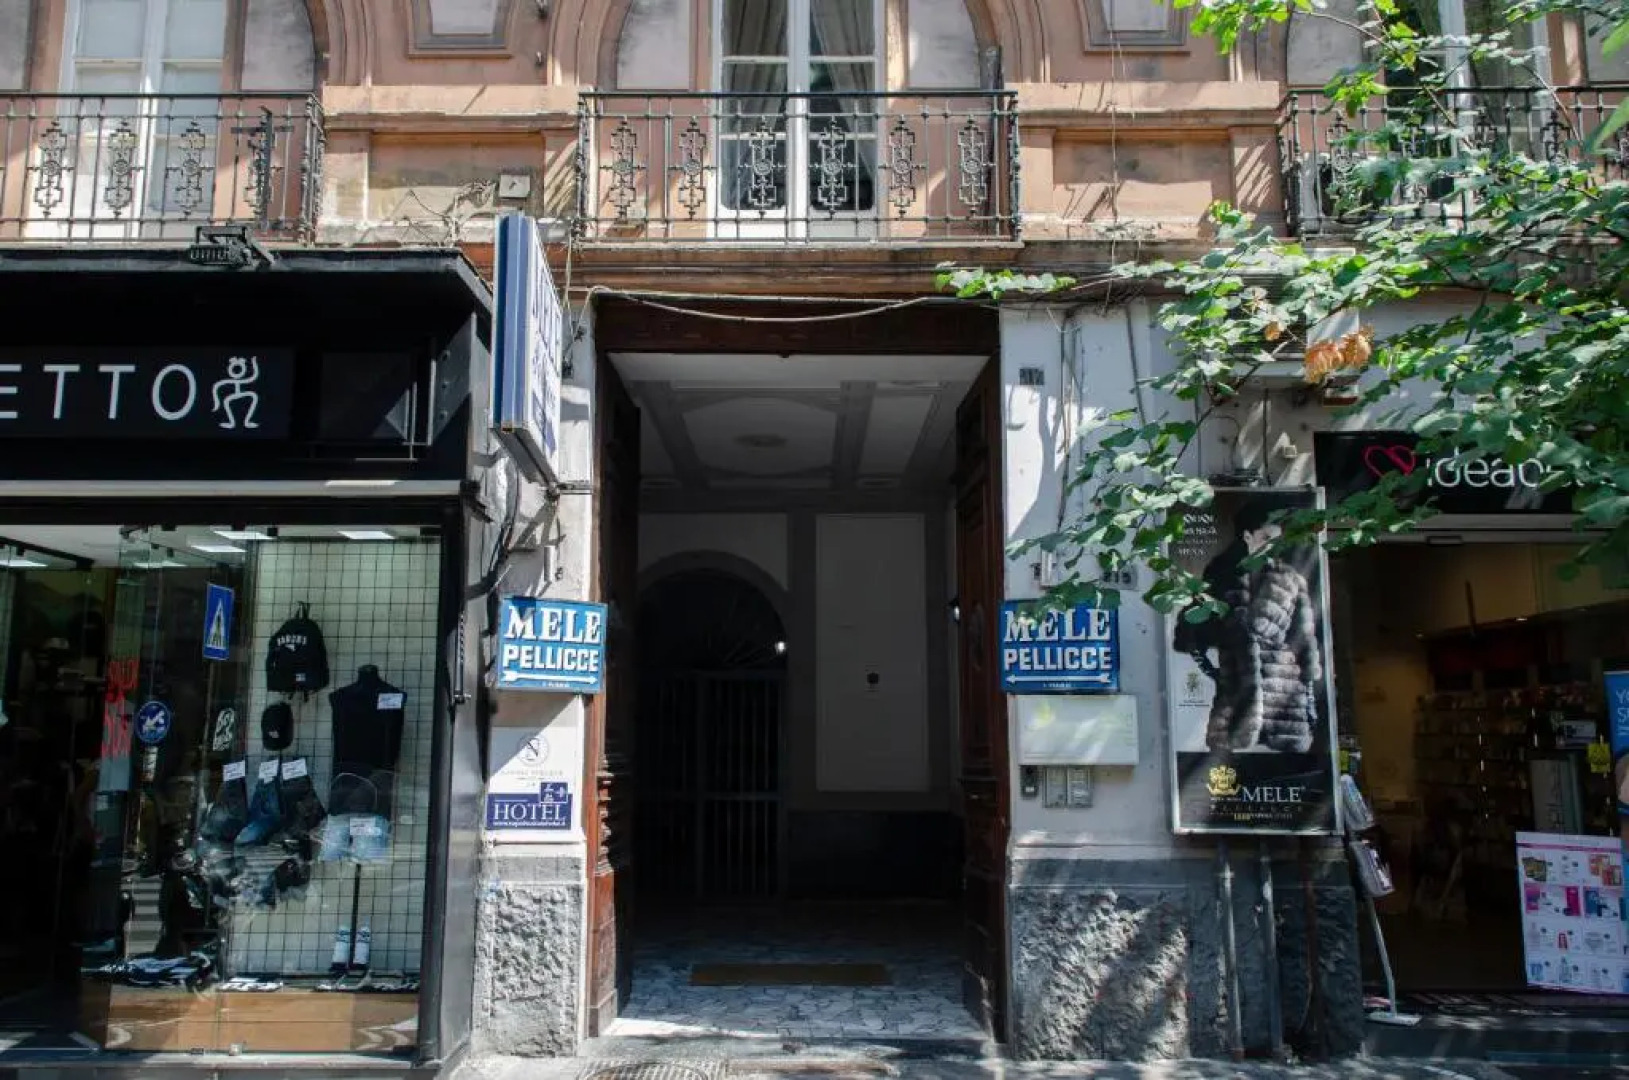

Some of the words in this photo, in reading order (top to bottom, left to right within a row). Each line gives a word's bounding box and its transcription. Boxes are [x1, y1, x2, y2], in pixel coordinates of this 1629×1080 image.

[504, 605, 601, 644] MELE
[1004, 608, 1111, 642] MELE
[503, 643, 599, 672] PELLICCE
[1003, 646, 1112, 670] PELLICCE
[1242, 785, 1302, 803] MELE
[494, 803, 566, 820] HOTEL
